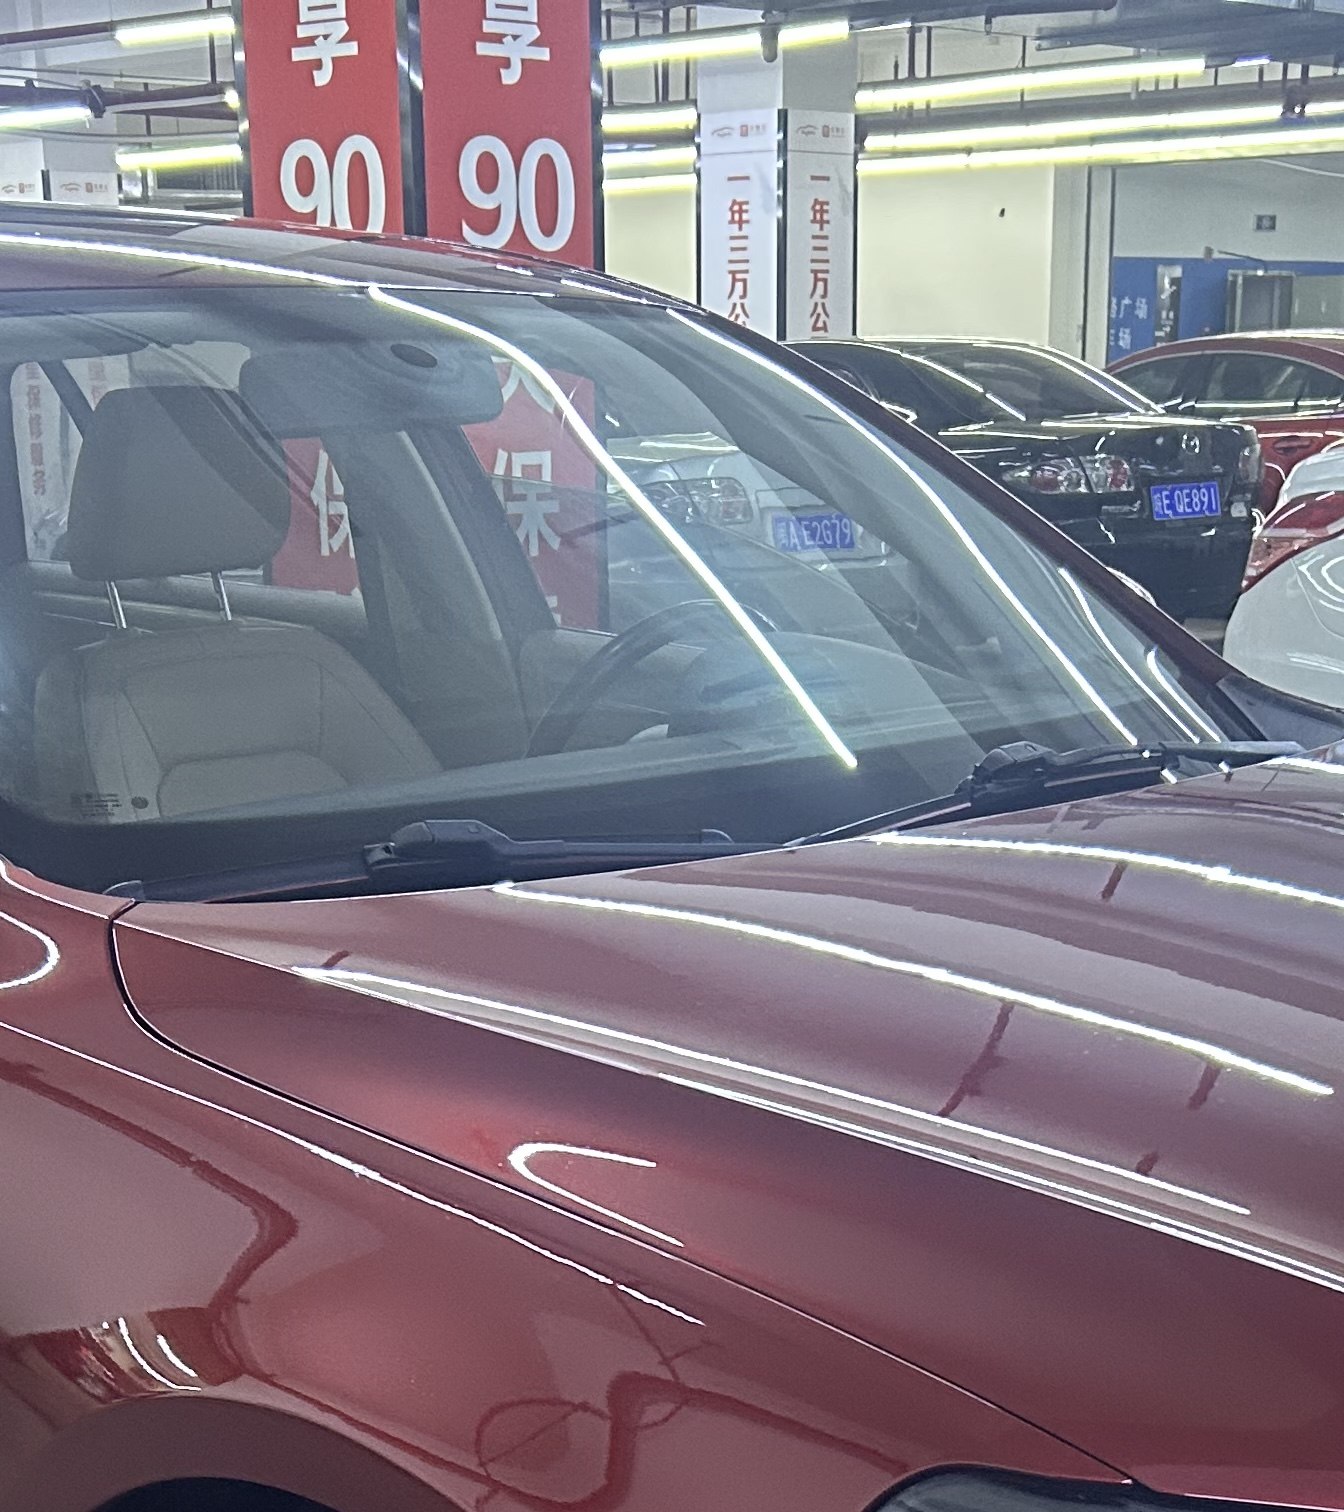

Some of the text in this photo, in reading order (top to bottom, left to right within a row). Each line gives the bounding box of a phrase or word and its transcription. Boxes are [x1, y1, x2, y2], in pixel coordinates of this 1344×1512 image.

[280, 135, 386, 234] 90
[459, 135, 575, 251] 90
[810, 175, 830, 333] 一年三万公
